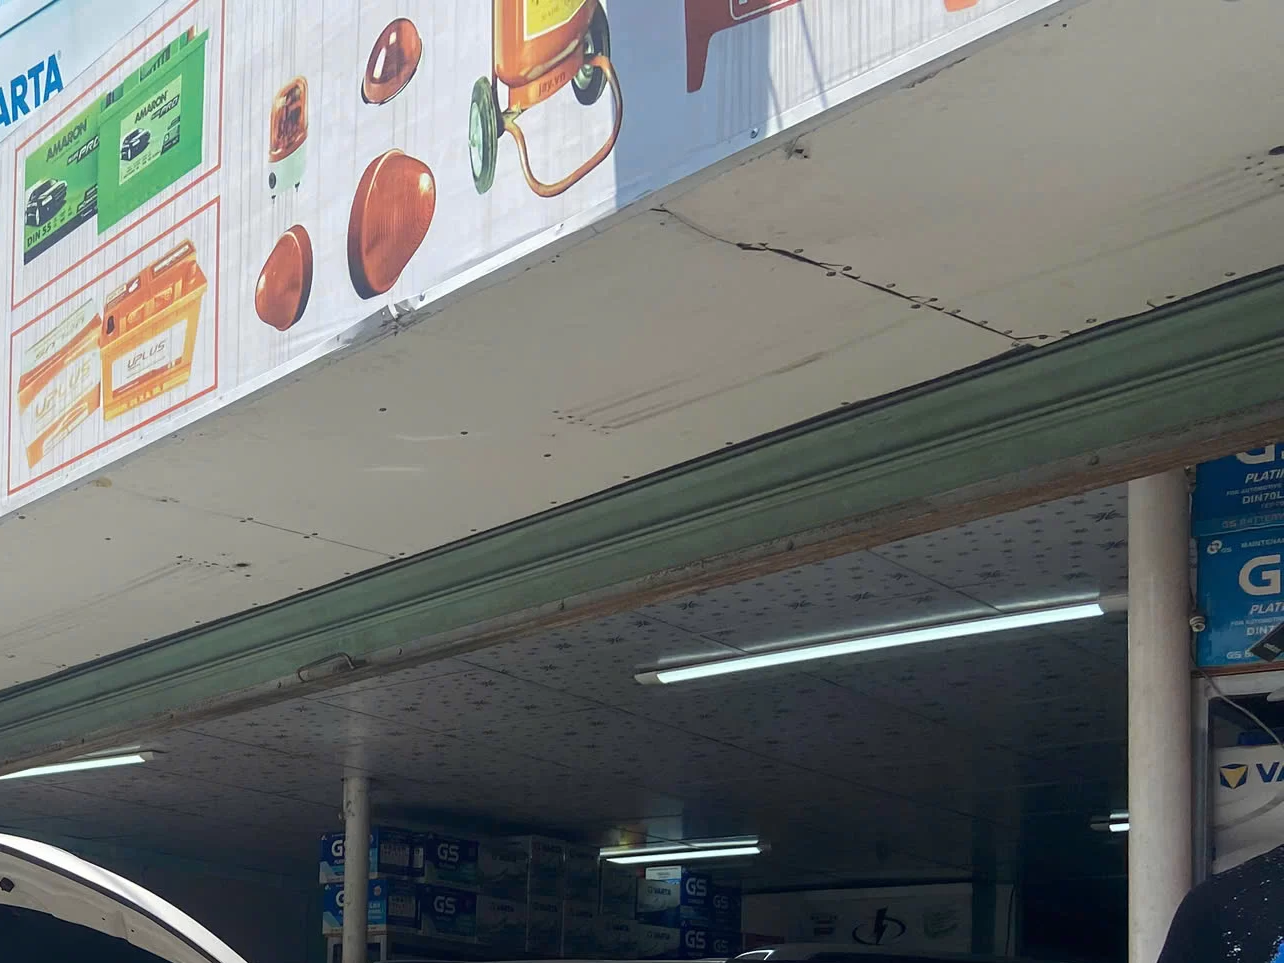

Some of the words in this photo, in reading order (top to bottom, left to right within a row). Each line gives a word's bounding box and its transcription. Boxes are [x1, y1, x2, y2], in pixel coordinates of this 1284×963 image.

[539, 72, 566, 97] jay.vn
[135, 90, 168, 124] AMARON
[46, 118, 87, 162] AMARON
[26, 230, 41, 248] DIN
[41, 223, 52, 237] 55
[686, 877, 708, 897] GS
[684, 930, 707, 949] GS
